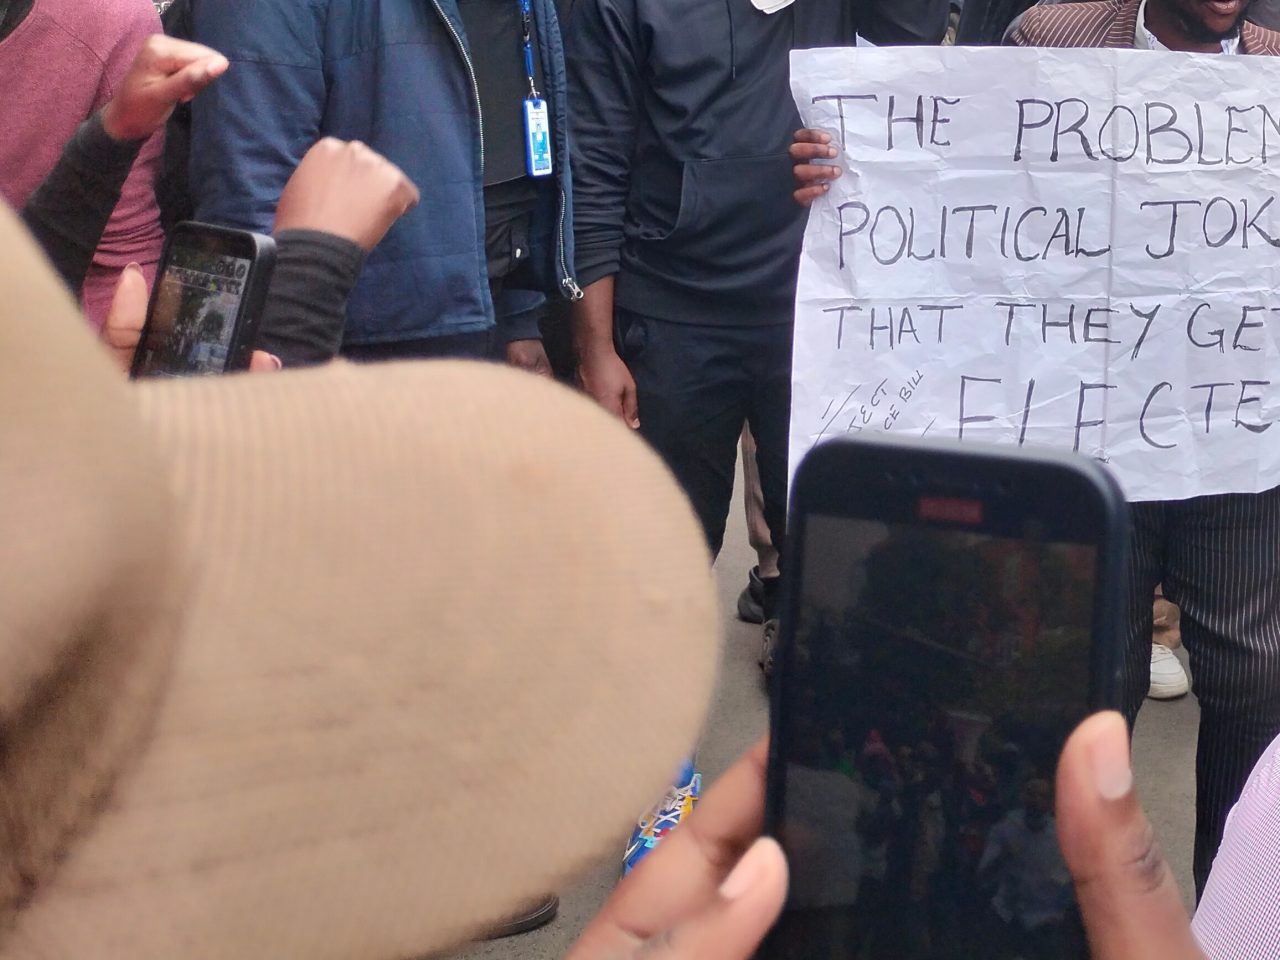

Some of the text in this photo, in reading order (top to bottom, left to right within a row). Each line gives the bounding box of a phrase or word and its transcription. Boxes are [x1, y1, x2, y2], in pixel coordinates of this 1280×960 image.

[811, 94, 961, 151] THE
[836, 200, 1110, 270] POLITICAL
[823, 304, 963, 350] THAT
[995, 301, 1161, 361] THEY
